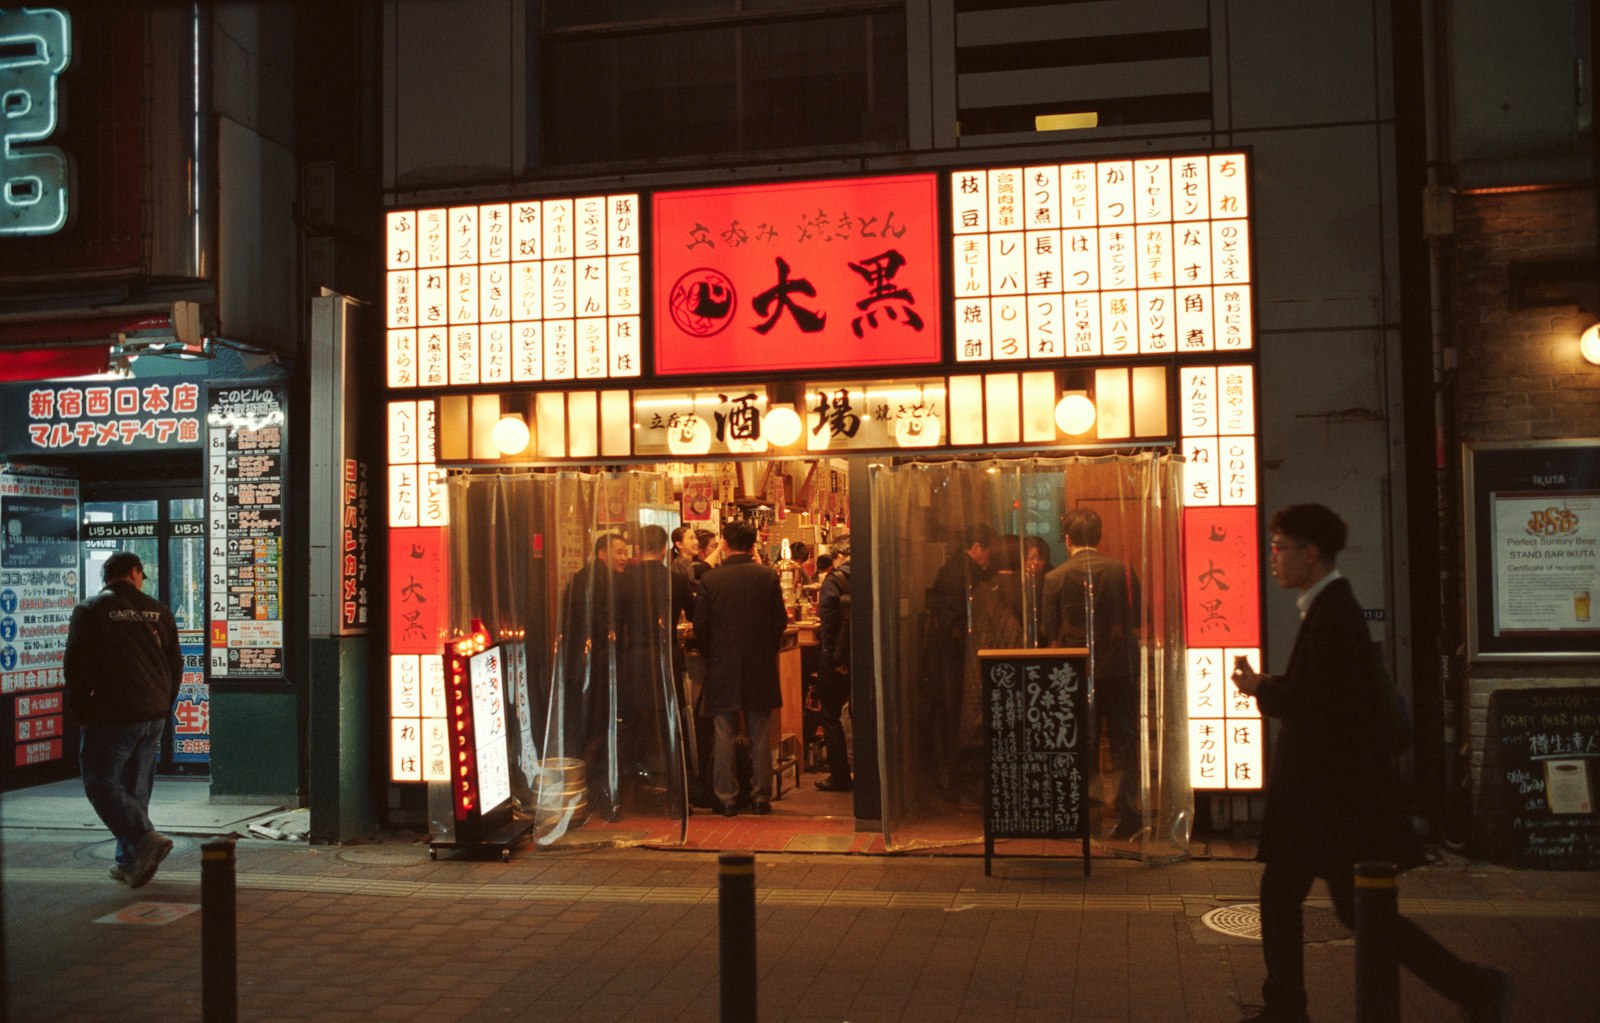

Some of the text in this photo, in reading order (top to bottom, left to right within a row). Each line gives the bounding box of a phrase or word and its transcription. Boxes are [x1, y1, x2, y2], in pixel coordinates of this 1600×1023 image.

[961, 176, 979, 227] 枝豆
[1034, 172, 1051, 224] もつ煮
[1071, 169, 1087, 220] ホッピー
[1107, 165, 1125, 217] がつ
[1145, 164, 1160, 218] ソーセージ
[1181, 162, 1198, 215] 赤セン
[1220, 160, 1237, 212] ちれ
[395, 216, 410, 263] ふわ
[459, 214, 471, 260] ハチノス
[489, 210, 502, 258] 牛カルビ
[519, 207, 535, 255] 冷奴
[584, 202, 598, 250] こぶくろ
[616, 199, 631, 248] 豚ひれ
[687, 208, 906, 250] 立呑み 焼きとん
[964, 240, 980, 291] 生ビール
[1000, 239, 1018, 289] レバ
[1035, 236, 1053, 289] 長芋
[1072, 235, 1089, 285] はつ
[1184, 229, 1201, 281] なす
[1222, 227, 1238, 279] のどぶえ
[427, 274, 442, 321] ねぎ
[490, 270, 503, 318] しきん
[553, 264, 566, 312] なんこつ
[584, 264, 600, 312] たん
[749, 250, 924, 339] 大黒
[964, 305, 982, 357] 焼酎
[1001, 305, 1018, 355] しろ
[1038, 302, 1054, 353] つくね
[1110, 298, 1128, 351] 豚バラ
[1149, 296, 1166, 349] ガツ芯
[1184, 294, 1205, 347] 角煮
[397, 336, 410, 384] はらみ
[490, 330, 503, 378] しいたけ
[586, 325, 600, 375] シマチョウ
[617, 322, 631, 370] ほほ
[29, 382, 200, 419] 新宿西口本店
[218, 389, 275, 404] このビルの
[1192, 375, 1207, 427] なんこつ
[28, 418, 200, 448] マルチメディア館
[398, 473, 411, 520] 上たん
[1192, 446, 1211, 498] ねぎ
[1230, 446, 1245, 499] しいたけ
[1533, 475, 1566, 486] IKUTA
[88, 525, 154, 537] いらっしゃいませ
[345, 458, 357, 623] ヨドバシカメラ
[1507, 537, 1596, 547] Perfect Suntory Beer
[1510, 551, 1541, 559] STAND
[1567, 550, 1595, 558] IKUTA
[60, 555, 75, 564] VISA
[1555, 564, 1595, 573] recognition
[400, 574, 427, 642] 大黒
[1198, 559, 1230, 634] 大黒
[1048, 662, 1079, 748] 焼きとん
[1196, 654, 1213, 708] ハチノス
[400, 724, 416, 773] れば
[431, 726, 444, 775] もつ煮
[1199, 724, 1216, 777] 牛カルビ
[1233, 726, 1251, 780] ほほ
[1529, 732, 1597, 754] 樽生達人
[1069, 768, 1082, 812] ホルモン
